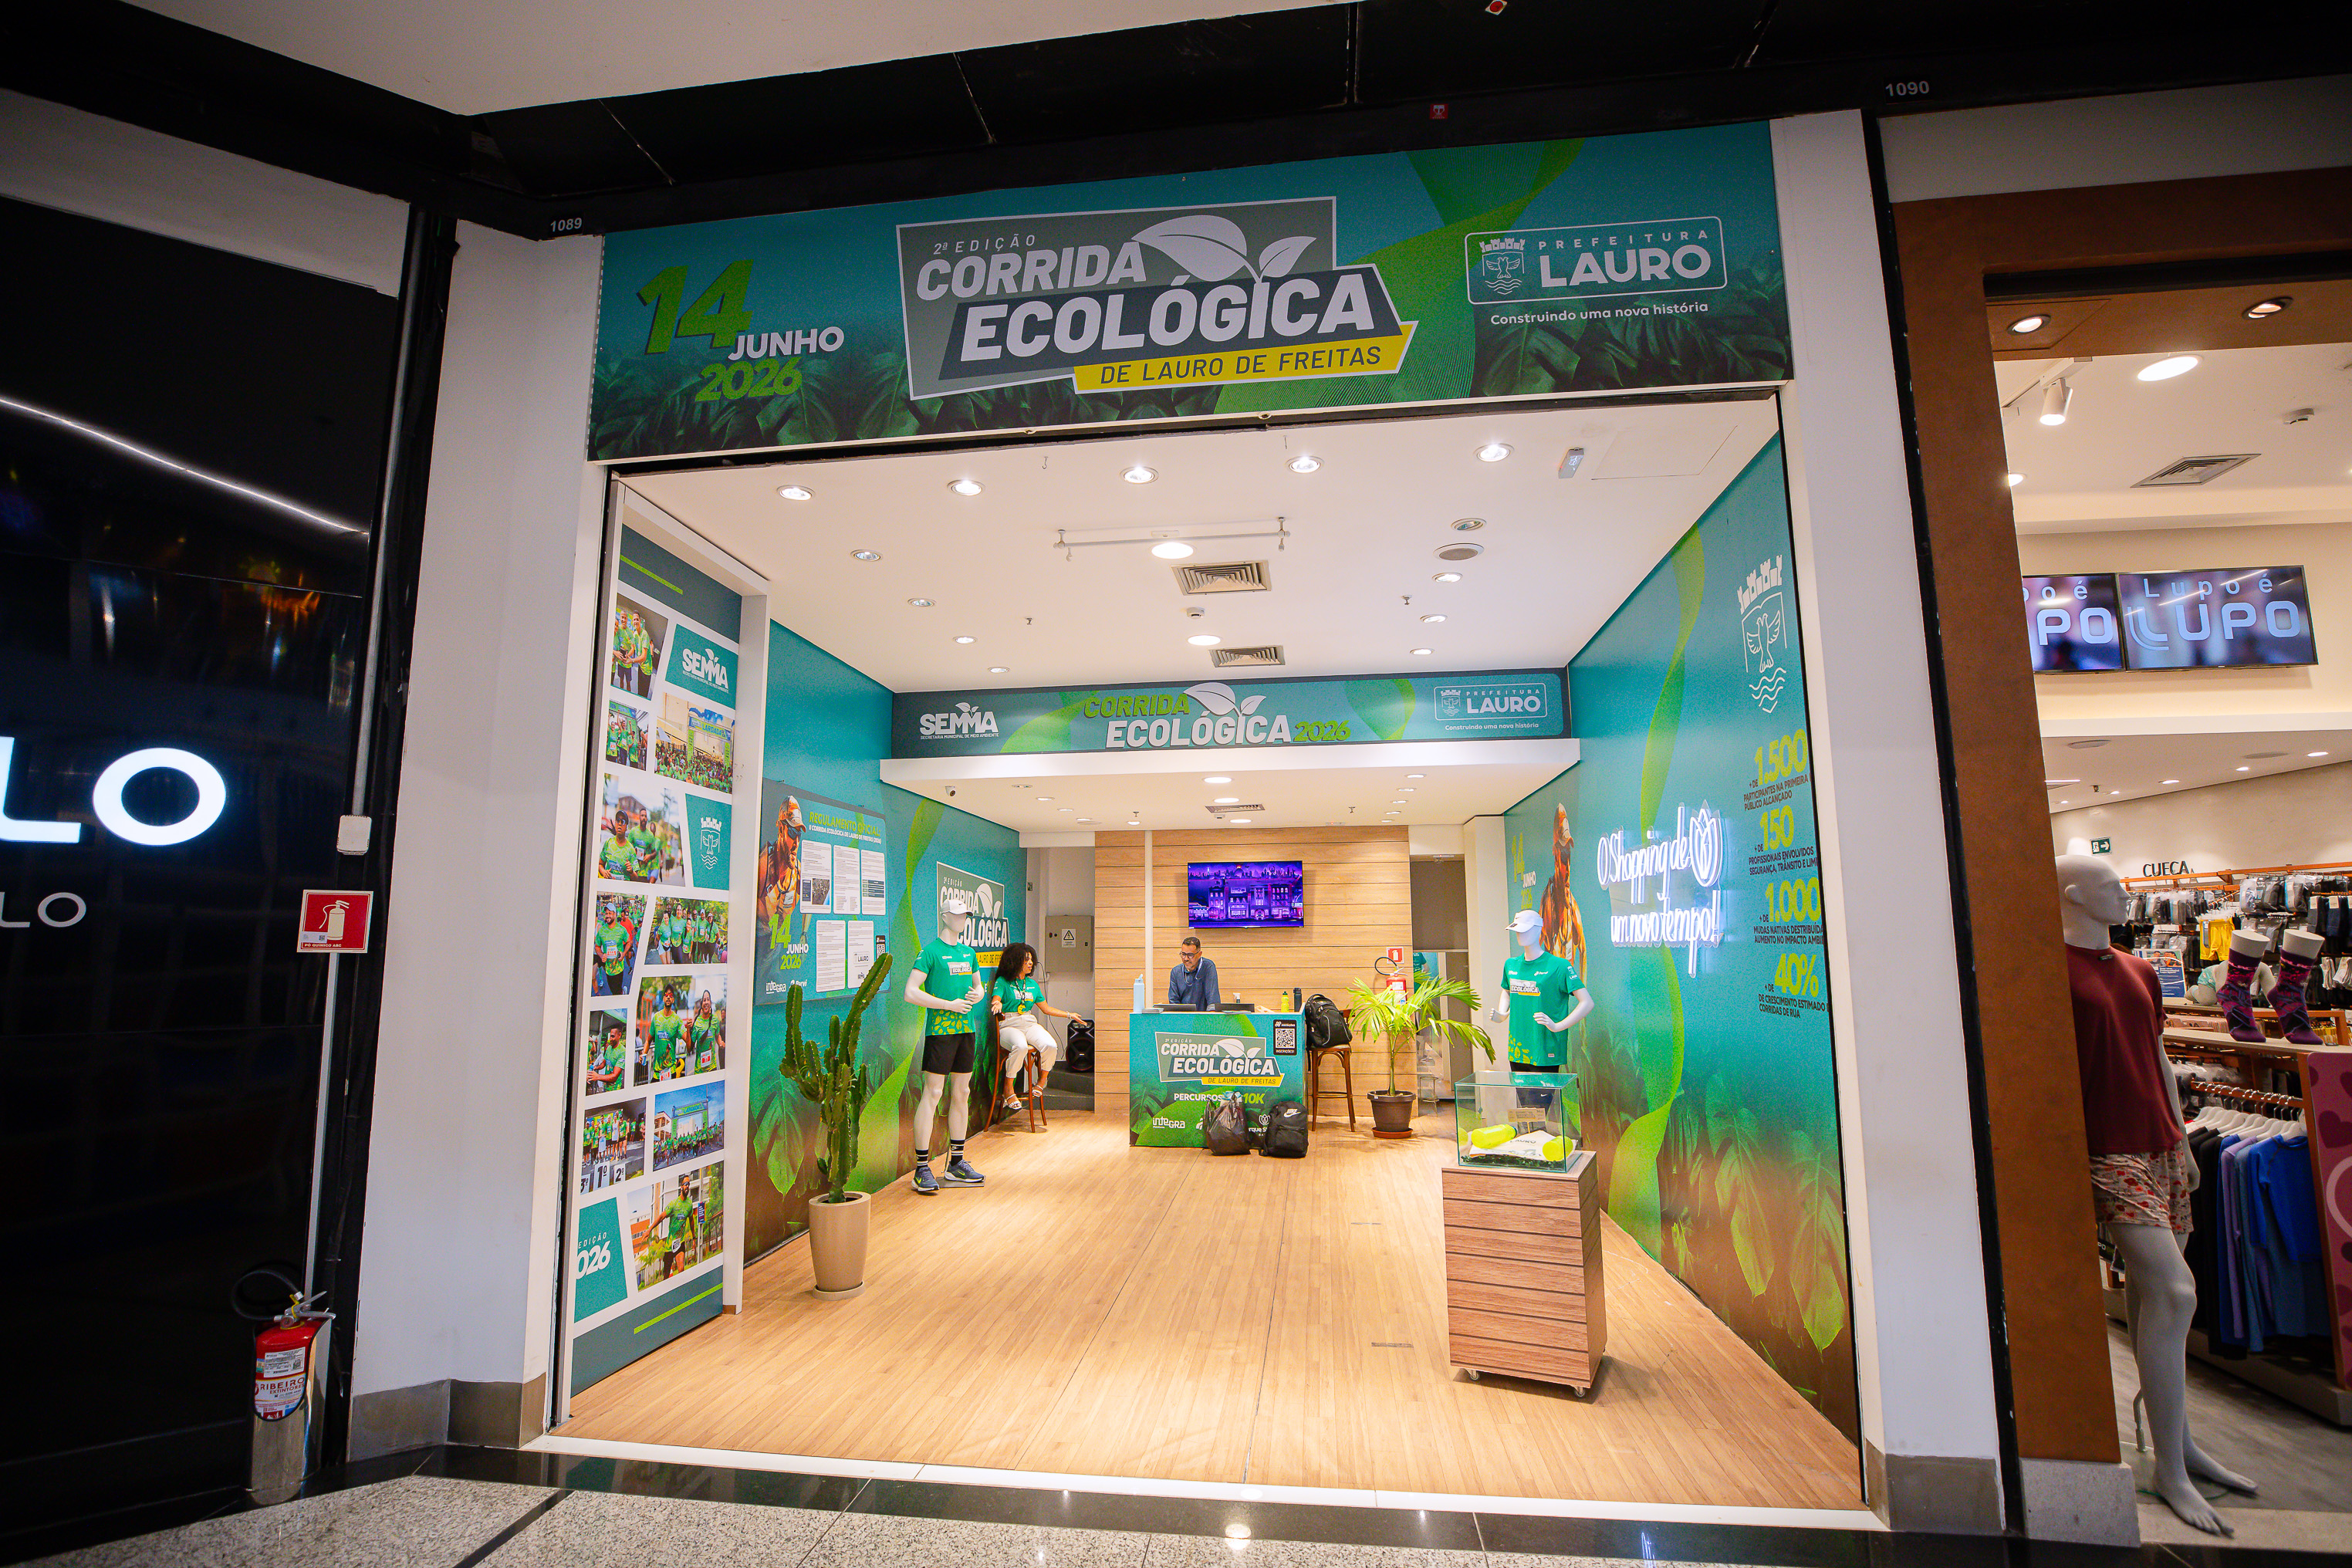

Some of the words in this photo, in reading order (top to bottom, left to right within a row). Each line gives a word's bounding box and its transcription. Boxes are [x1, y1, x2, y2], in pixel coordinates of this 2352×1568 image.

[1885, 80, 1929, 96] 1090
[549, 217, 583, 232] 1089
[933, 242, 948, 255] 2ª
[955, 234, 1036, 252] EDIÇÃO
[1539, 230, 1708, 250] PREFEITURA
[917, 242, 1147, 301] CORRIDA
[1539, 245, 1712, 288] LAURO
[636, 259, 754, 355] 14
[961, 274, 1374, 362] ECOLÓGICA
[1491, 309, 1576, 325] Construindo
[1580, 308, 1611, 319] uma
[1615, 306, 1650, 317] nova
[1653, 302, 1708, 316] história
[728, 326, 845, 360] JUNHO
[1101, 364, 1131, 384] DE
[1142, 357, 1223, 381] LAURO
[1236, 354, 1267, 374] DE
[1279, 346, 1381, 372] FREITAS
[694, 357, 803, 402] 2026
[2036, 607, 2114, 646] PO
[2127, 600, 2301, 651] LUPO
[682, 648, 728, 689] SEMMA
[1083, 694, 1191, 718] CORRIDA
[1467, 696, 1541, 714] LAURO
[919, 711, 999, 735] SEMMA
[1106, 710, 1292, 748] ECOLÓGICA
[1293, 720, 1351, 742] 2026
[1754, 728, 1808, 786] 1.500
[1744, 784, 1776, 803] PARTICIPANTES
[1776, 782, 1784, 792] NA
[1784, 773, 1809, 789] PRIMEIRA
[1752, 779, 1758, 788] DE
[1762, 789, 1793, 806] ALCANÇADO
[809, 812, 857, 832] REGULAMENTO
[857, 823, 881, 836] OFICIAL:
[811, 825, 827, 833] CORRIDA
[1759, 805, 1795, 851] 150
[1511, 832, 1525, 883] 14
[1749, 852, 1781, 865] PROFISSIONAIS
[1782, 846, 1814, 860] ENVOLVIDOS
[1757, 843, 1764, 853] DE
[1597, 836, 1610, 885] O
[1610, 830, 1671, 905] Shopping
[1749, 863, 1778, 875] SEGURANÇA,
[1778, 860, 1802, 872] TRÂNSITO
[1802, 860, 1806, 868] E
[2143, 860, 2189, 877] CUECA
[1523, 870, 1536, 888] JUNHO
[1765, 877, 1822, 923] 1.000
[1753, 925, 1770, 934] MUDAS
[1770, 925, 1790, 934] NATIVAS
[1762, 914, 1769, 923] DE
[768, 914, 792, 949] 14
[958, 913, 1008, 948] OLÓGICA
[1630, 912, 1659, 942] novo
[1661, 890, 1721, 975] tempo!
[1754, 935, 1776, 944] AUMENTO
[1776, 935, 1784, 944] NO
[1784, 935, 1806, 945] IMPACTO
[786, 943, 809, 955] JUNHO
[780, 954, 802, 970] 2026
[1768, 984, 1774, 992] DE
[1774, 952, 1820, 998] 40%
[1759, 994, 1765, 1002] DE
[1765, 995, 1797, 1008] CRESCIMENTO
[1798, 999, 1826, 1012] ESTIMADO
[1759, 1003, 1783, 1015] CORRIDAS
[1783, 1007, 1789, 1017] DE
[1789, 1009, 1801, 1019] RUA
[1161, 1043, 1220, 1056] CORRIDA
[1172, 1054, 1275, 1076] ECOLÓGICA
[1174, 1093, 1223, 1102] PERCURSOS
[1243, 1093, 1266, 1104] 10K
[597, 1165, 607, 1188] 1º
[615, 1168, 624, 1182] 2º
[578, 1232, 607, 1249] EDIÇÃO
[260, 1377, 305, 1391] RIBEIRO
